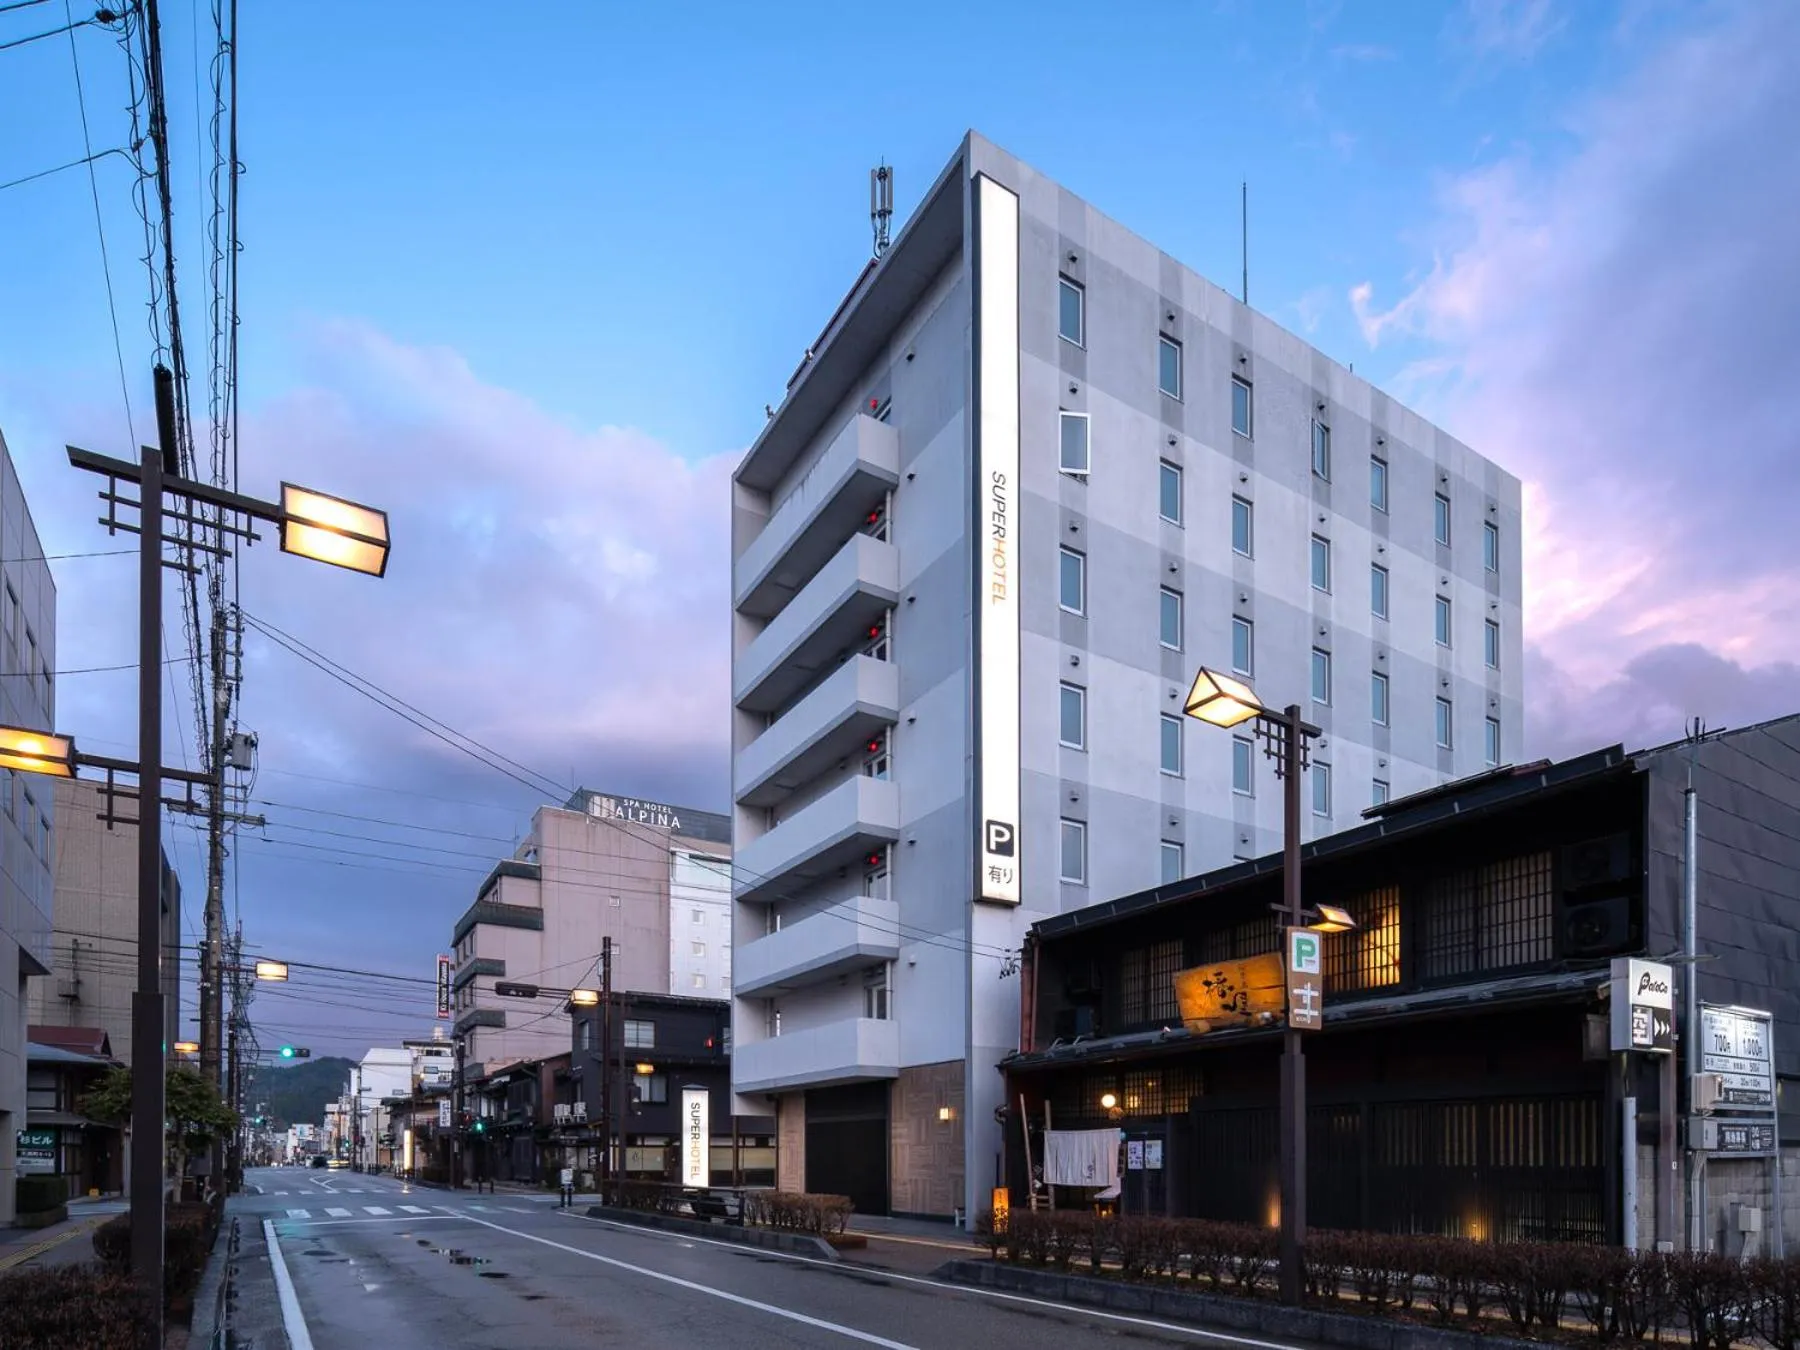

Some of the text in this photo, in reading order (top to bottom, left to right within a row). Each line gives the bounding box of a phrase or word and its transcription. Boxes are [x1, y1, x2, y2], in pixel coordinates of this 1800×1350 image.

[992, 471, 1007, 605] SUPERHOTEL
[616, 805, 680, 828] ALPINA
[624, 799, 672, 815] SPA HOTEL
[990, 825, 1011, 850] P
[988, 865, 1013, 884] 有り
[1296, 937, 1316, 969] P
[690, 1102, 701, 1180] SUPERHOTEL
